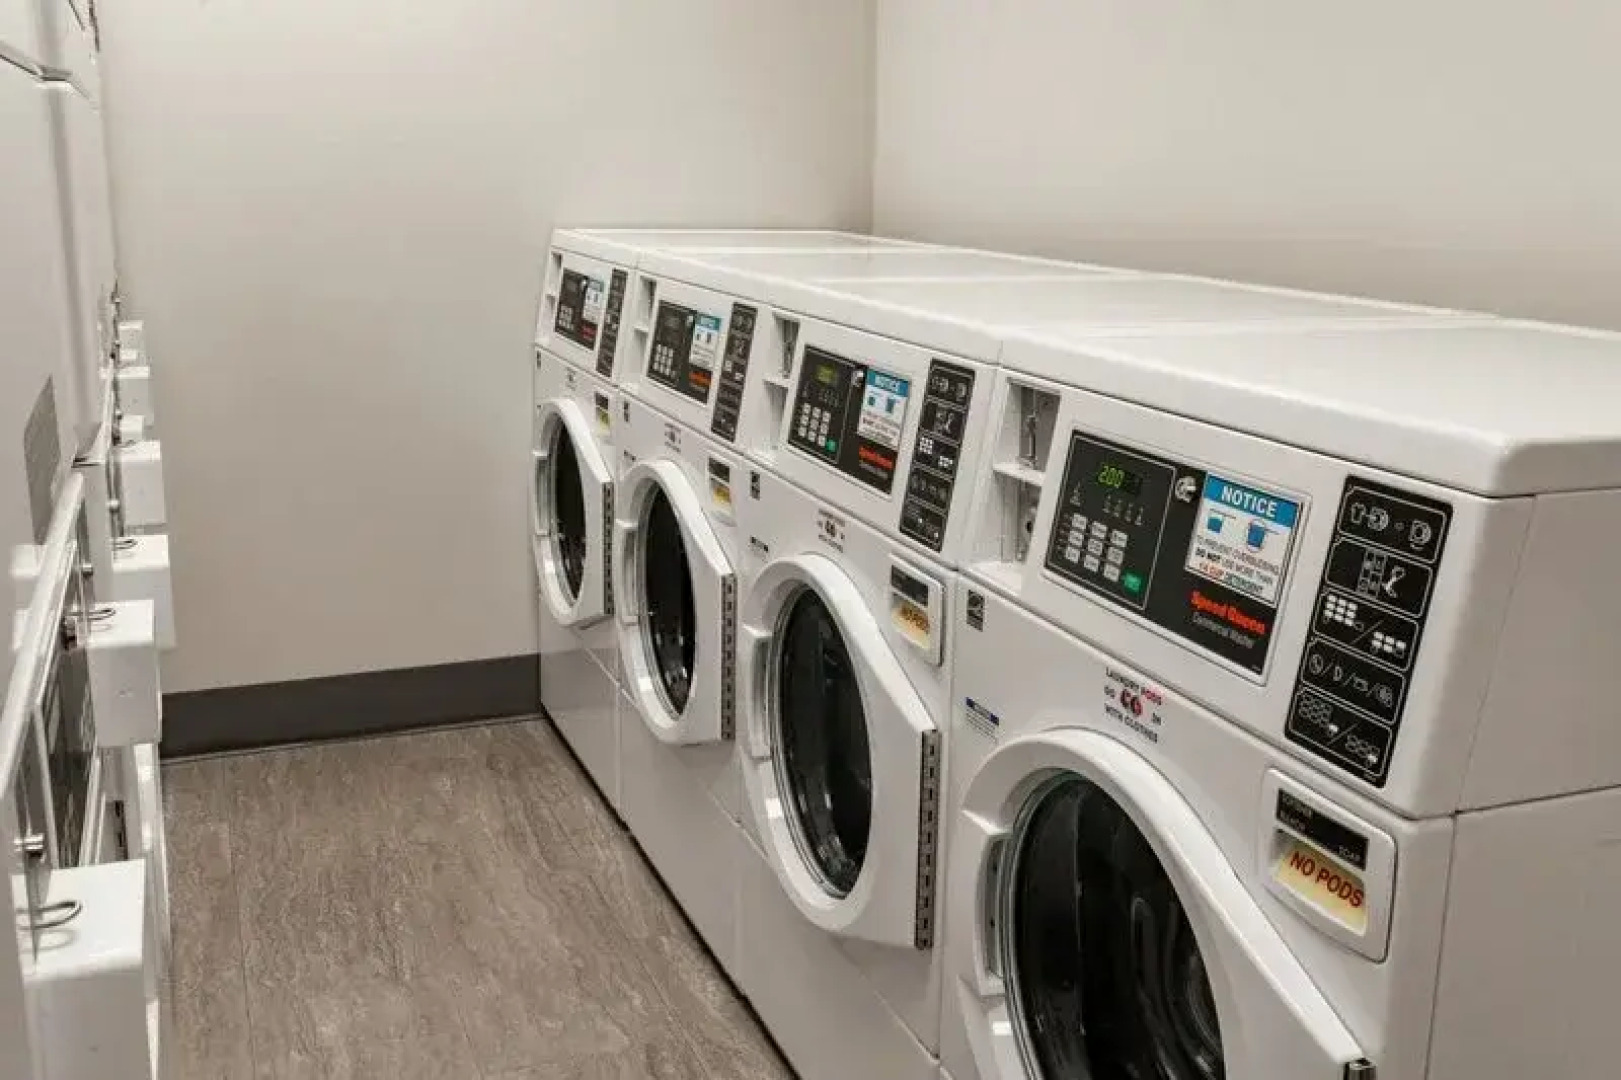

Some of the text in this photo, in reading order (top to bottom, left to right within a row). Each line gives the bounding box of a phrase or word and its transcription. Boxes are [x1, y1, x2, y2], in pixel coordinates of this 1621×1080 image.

[1098, 465, 1124, 489] 200
[1221, 484, 1278, 518] NOTICE
[1191, 590, 1265, 635] Speed Queen
[1289, 851, 1364, 908] NO PODS
